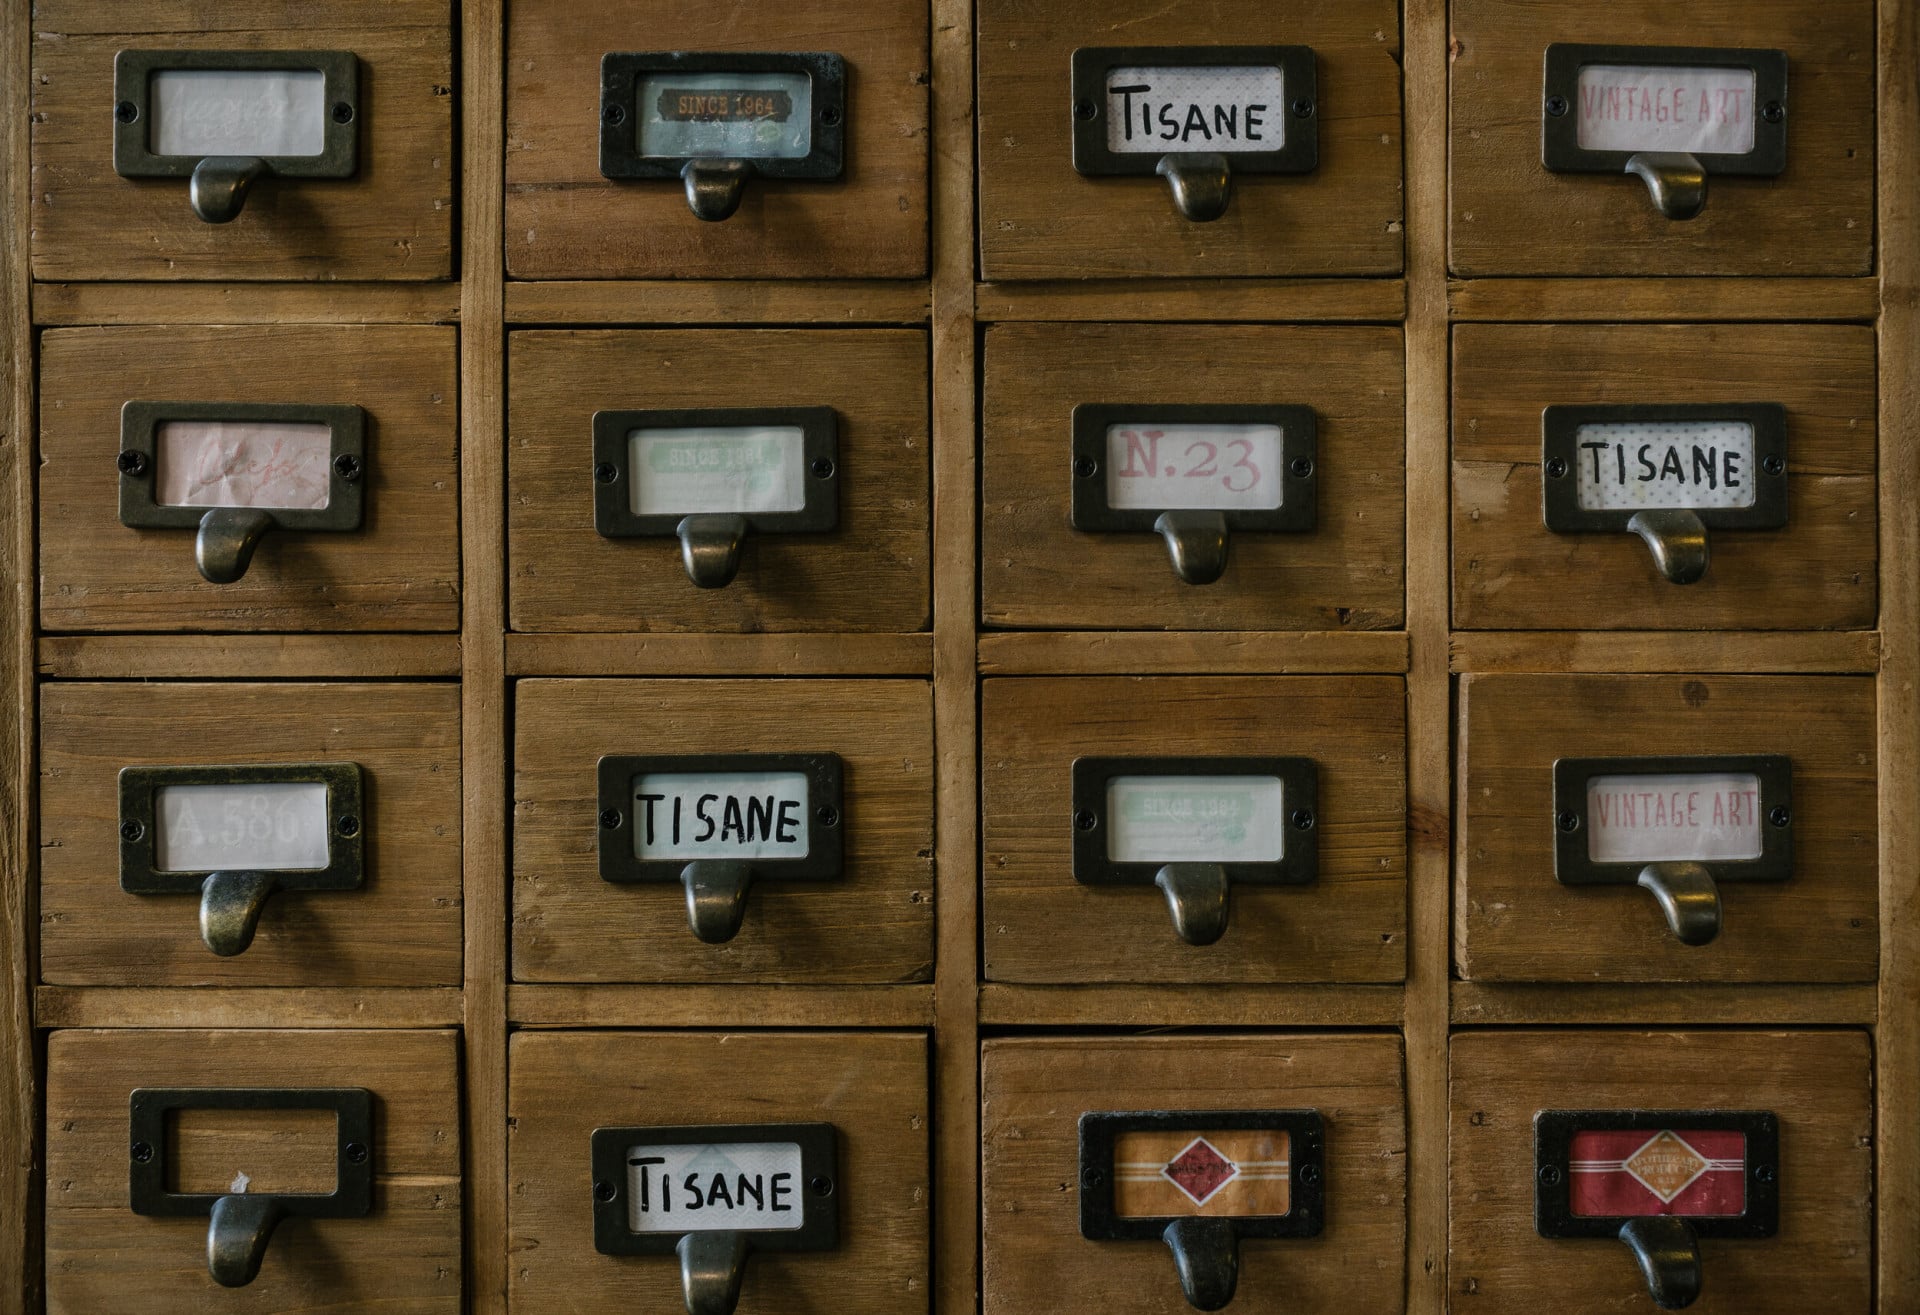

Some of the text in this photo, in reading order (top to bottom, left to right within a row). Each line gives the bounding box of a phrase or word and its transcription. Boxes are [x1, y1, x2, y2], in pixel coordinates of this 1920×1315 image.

[678, 96, 775, 115] SINCE 1964
[1582, 84, 1746, 123] VINTAGE ART
[1118, 430, 1262, 492] N.23
[1581, 442, 1742, 490] TISANE
[636, 794, 801, 845] TISANE
[1597, 789, 1757, 828] VINTAGE ART
